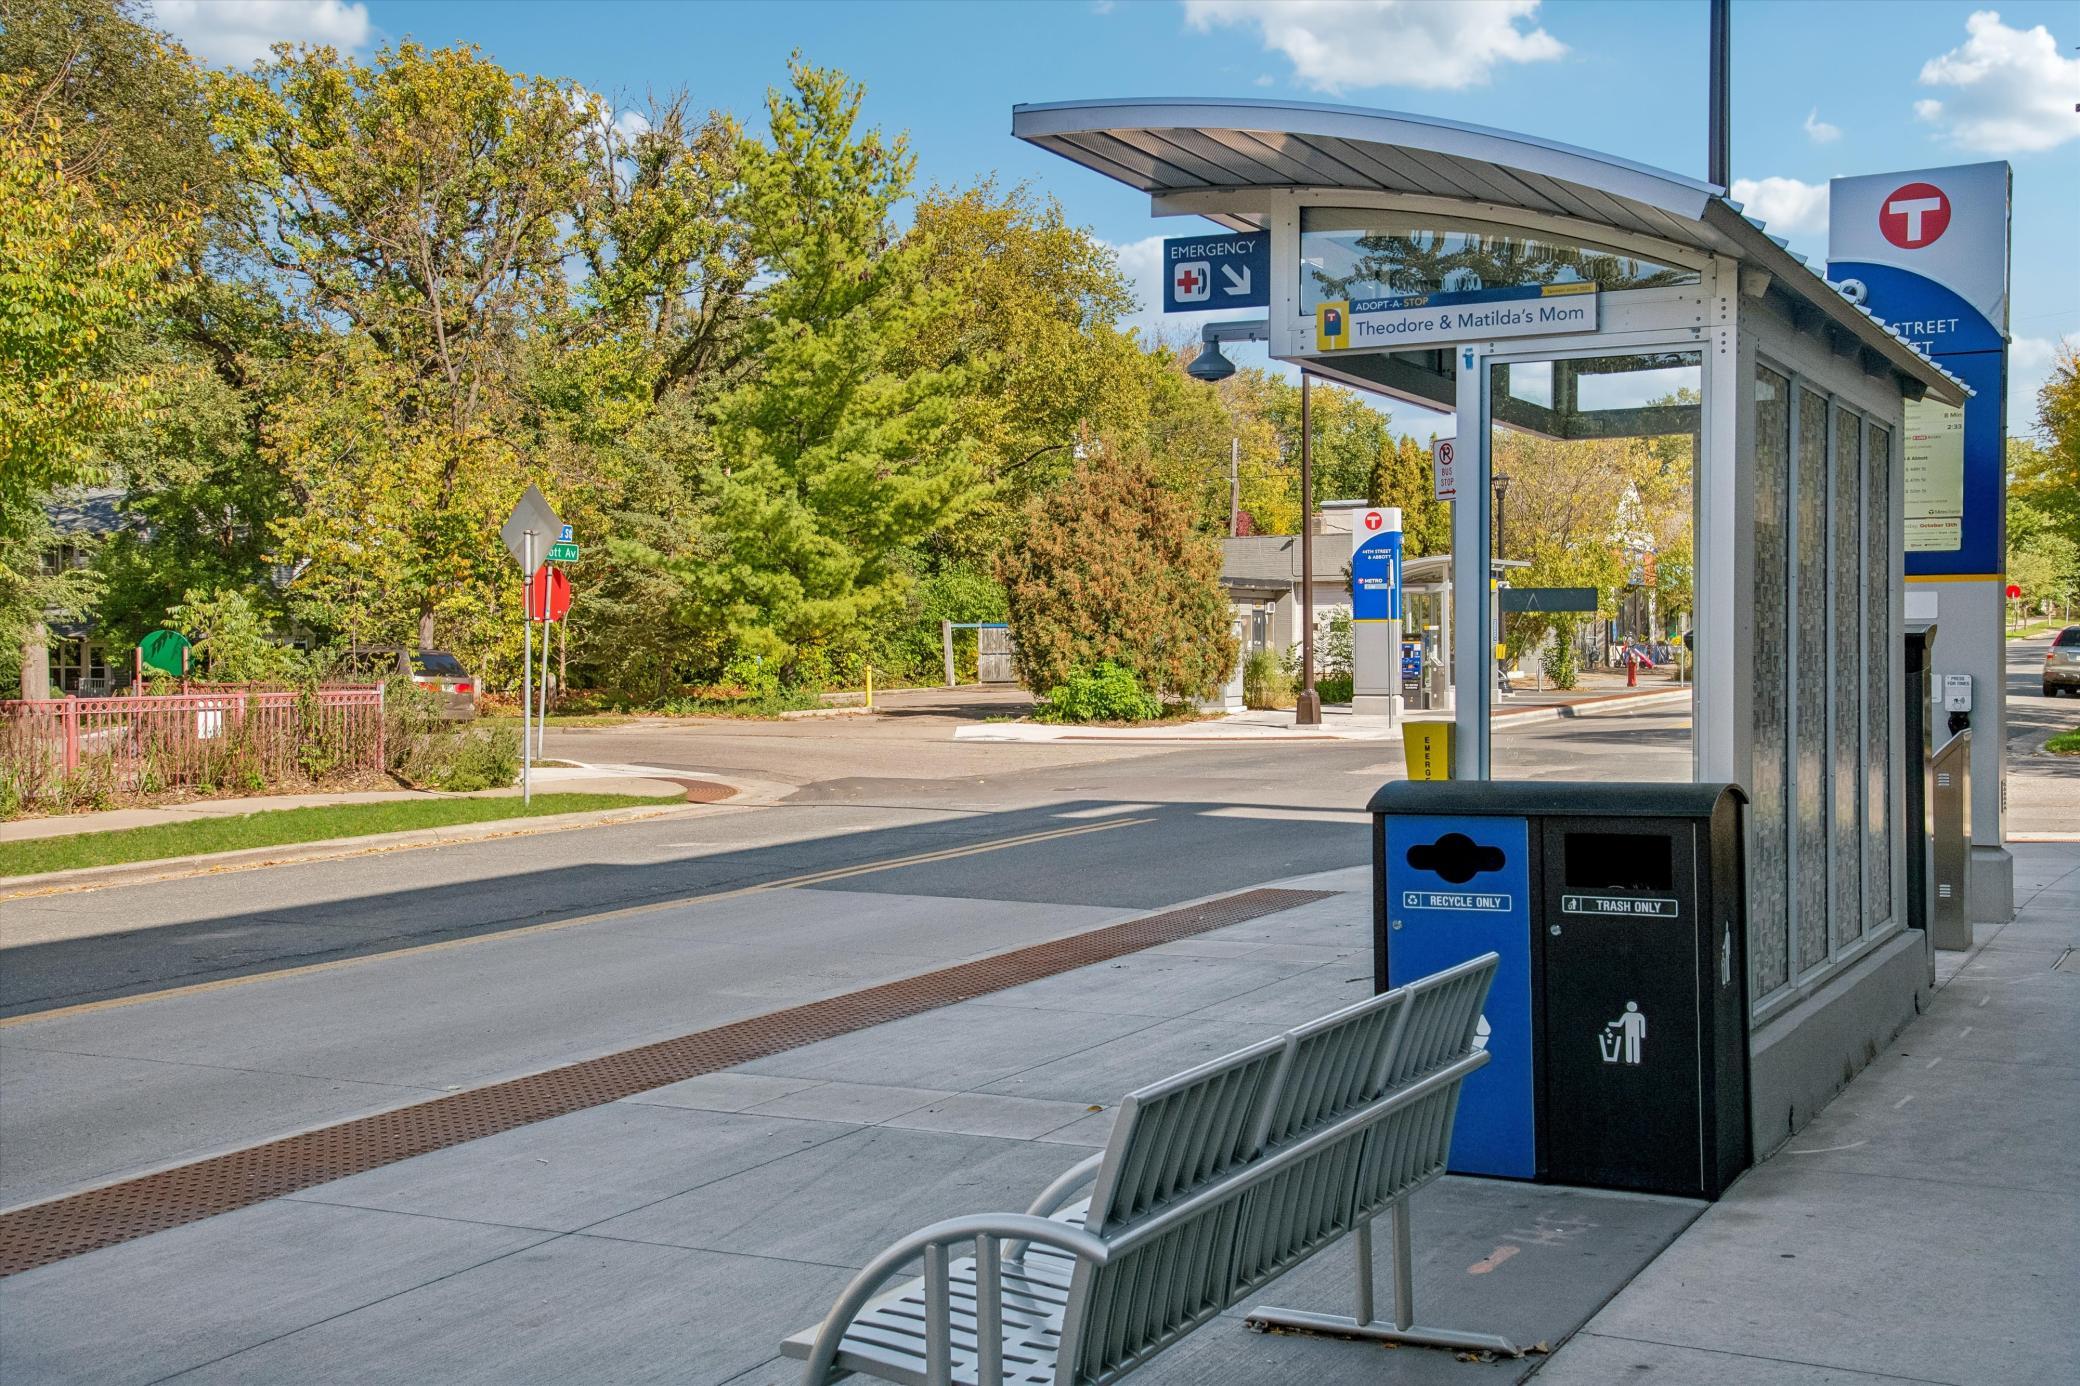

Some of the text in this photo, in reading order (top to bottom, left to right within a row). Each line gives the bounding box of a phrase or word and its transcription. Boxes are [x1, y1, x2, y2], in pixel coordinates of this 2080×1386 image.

[1888, 196, 1941, 241] T
[1171, 240, 1256, 259] EMERGENCY
[1355, 297, 1429, 312] ADOPT-A-STOP
[1356, 306, 1584, 337] Theodore & Matilda's Mom
[1441, 467, 1453, 476] BUS
[1440, 478, 1454, 487] STOP
[1366, 515, 1380, 529] T
[565, 548, 577, 558] Av
[1429, 895, 1501, 909] RECYCLE ONLY
[1596, 899, 1662, 914] TRASH ONLY
